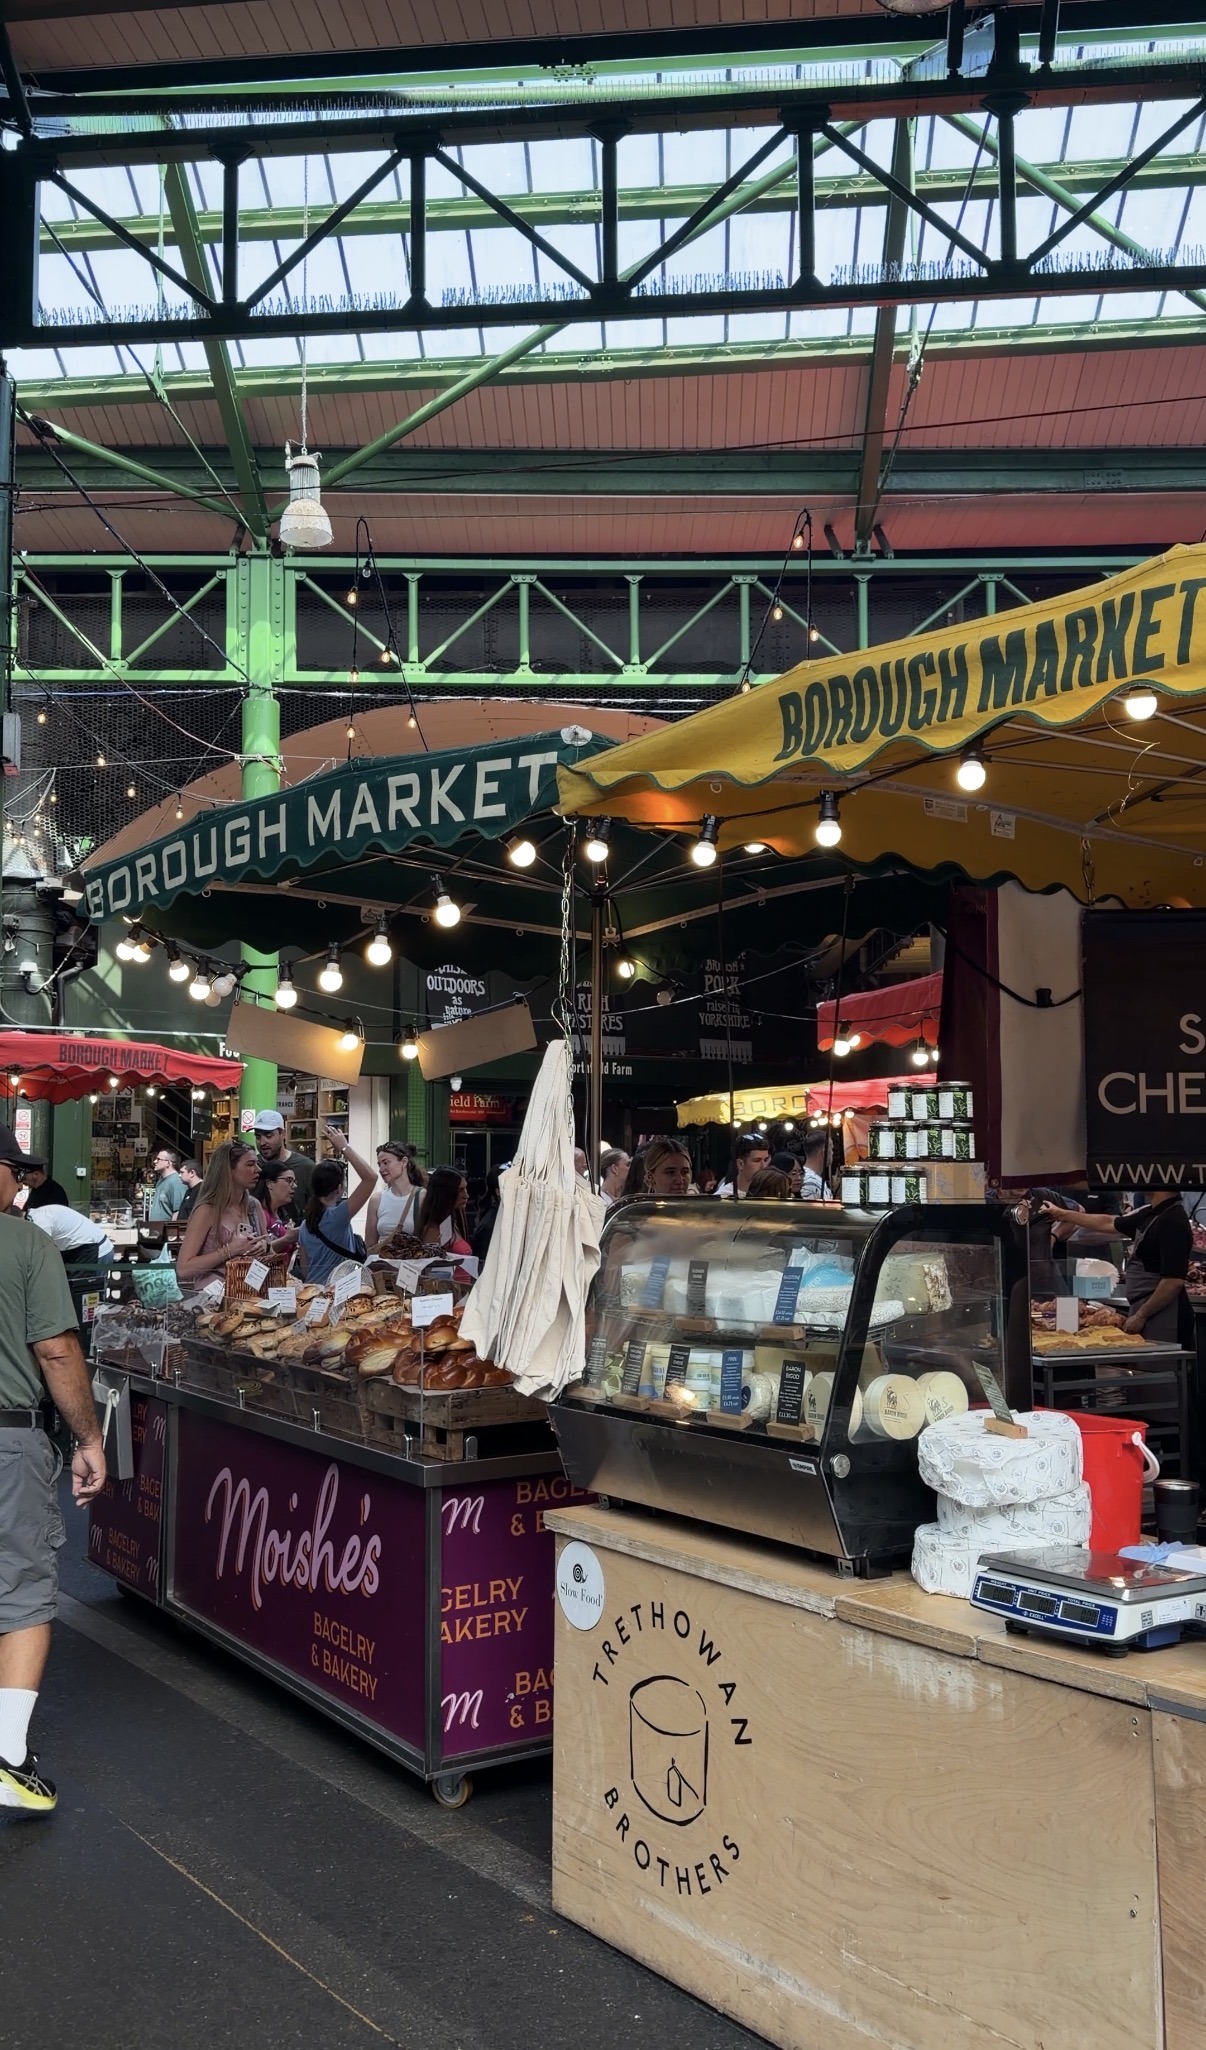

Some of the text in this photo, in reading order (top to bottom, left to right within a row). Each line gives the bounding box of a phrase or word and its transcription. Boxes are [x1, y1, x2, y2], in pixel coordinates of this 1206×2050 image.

[774, 577, 1206, 762] BOROUGH MARKET
[85, 752, 558, 919] BOROUGH MARKET
[427, 975, 486, 996] OUTDOORS
[452, 996, 463, 1005] as
[578, 993, 609, 1013] RIH
[698, 1012, 750, 1029] YORKSHIRE
[59, 1043, 171, 1073] BOROUGH MARKET
[612, 1062, 632, 1075] Farm
[473, 1096, 501, 1108] Farm
[1098, 1071, 1206, 1115] CHE
[205, 1463, 382, 1611] Moishe's
[511, 1514, 526, 1536] &
[108, 1527, 141, 1558] BAGELRY
[106, 1554, 141, 1583] & BAKERY
[560, 1581, 601, 1607] Slow Food
[314, 1611, 375, 1665] BAGELRY
[311, 1643, 378, 1701] & BAKERY
[592, 1601, 752, 1745] TRETHOWAN
[510, 1705, 525, 1729] &
[604, 1787, 740, 1896] BROTHERS
